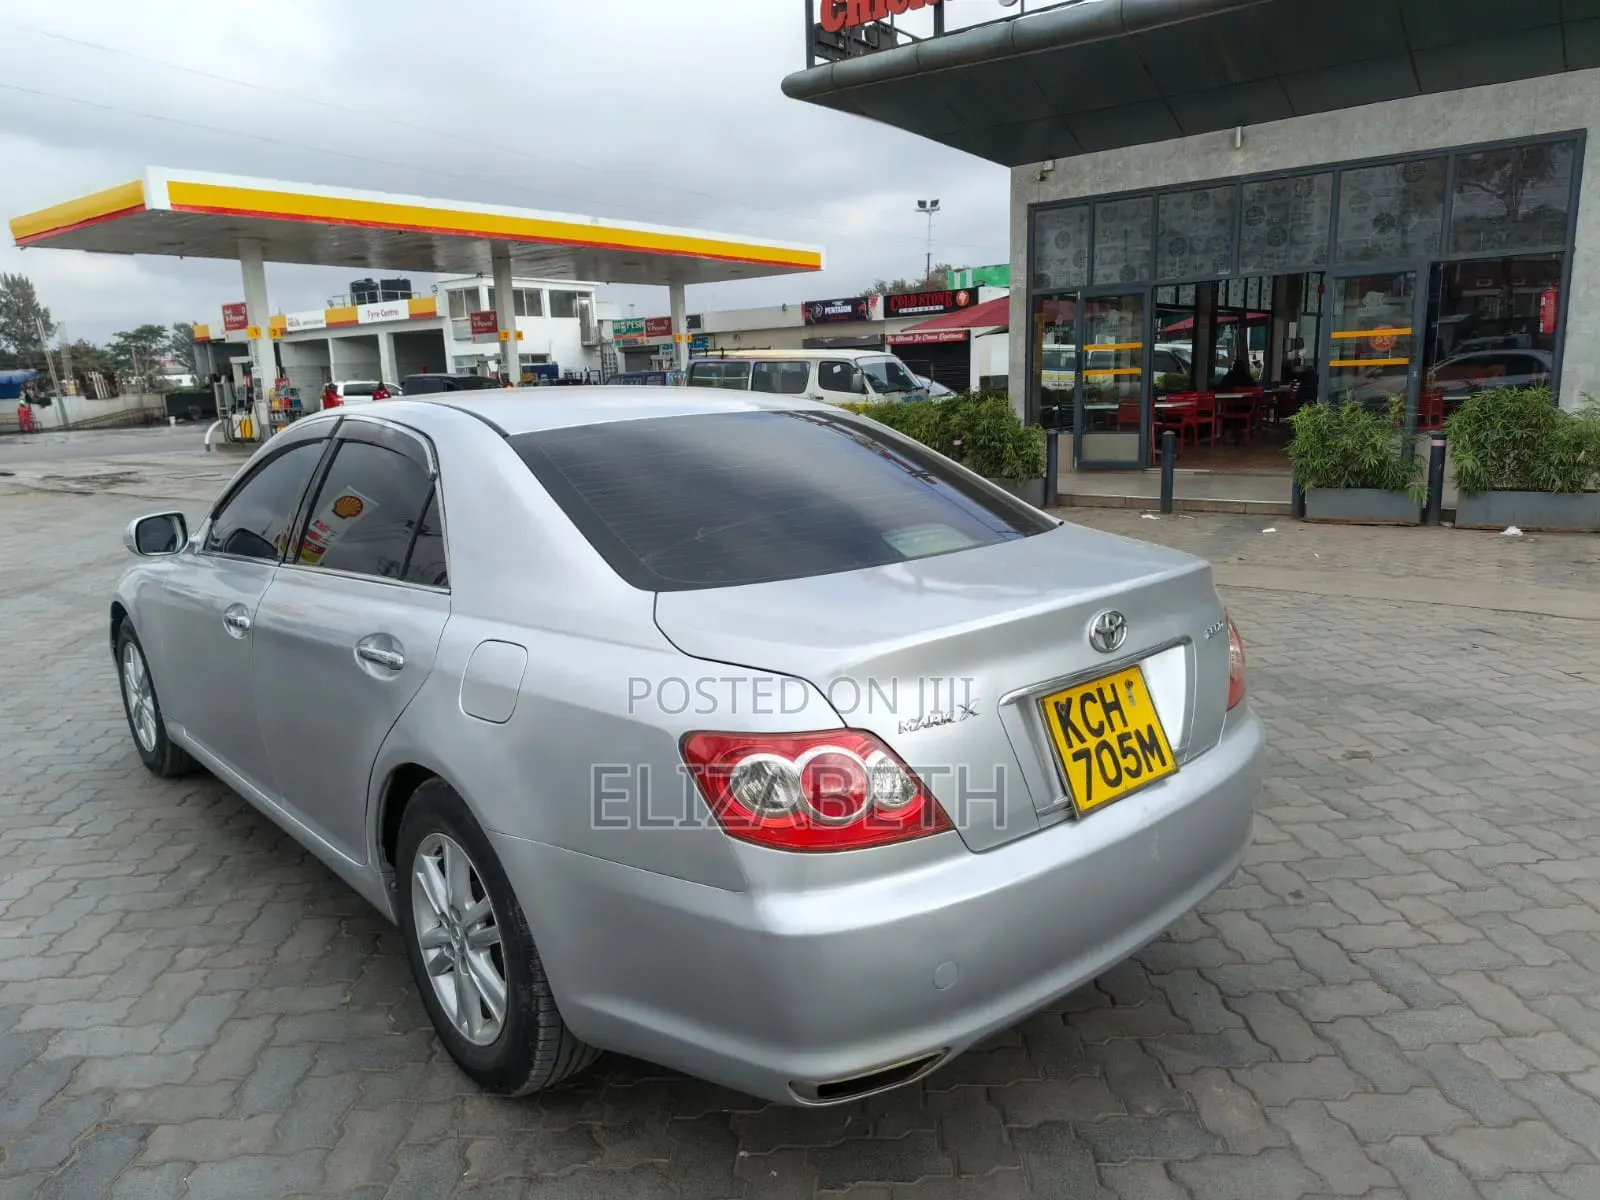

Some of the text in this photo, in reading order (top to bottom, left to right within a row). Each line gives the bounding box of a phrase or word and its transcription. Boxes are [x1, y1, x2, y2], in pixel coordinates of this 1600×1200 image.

[367, 308, 399, 320] Tyre Centre
[824, 304, 852, 315] PENTAGON
[890, 295, 917, 312] COLD
[918, 291, 952, 308] STONE
[897, 697, 982, 735] MARK X
[1053, 682, 1129, 749] KCH
[1071, 723, 1168, 803] 705M
